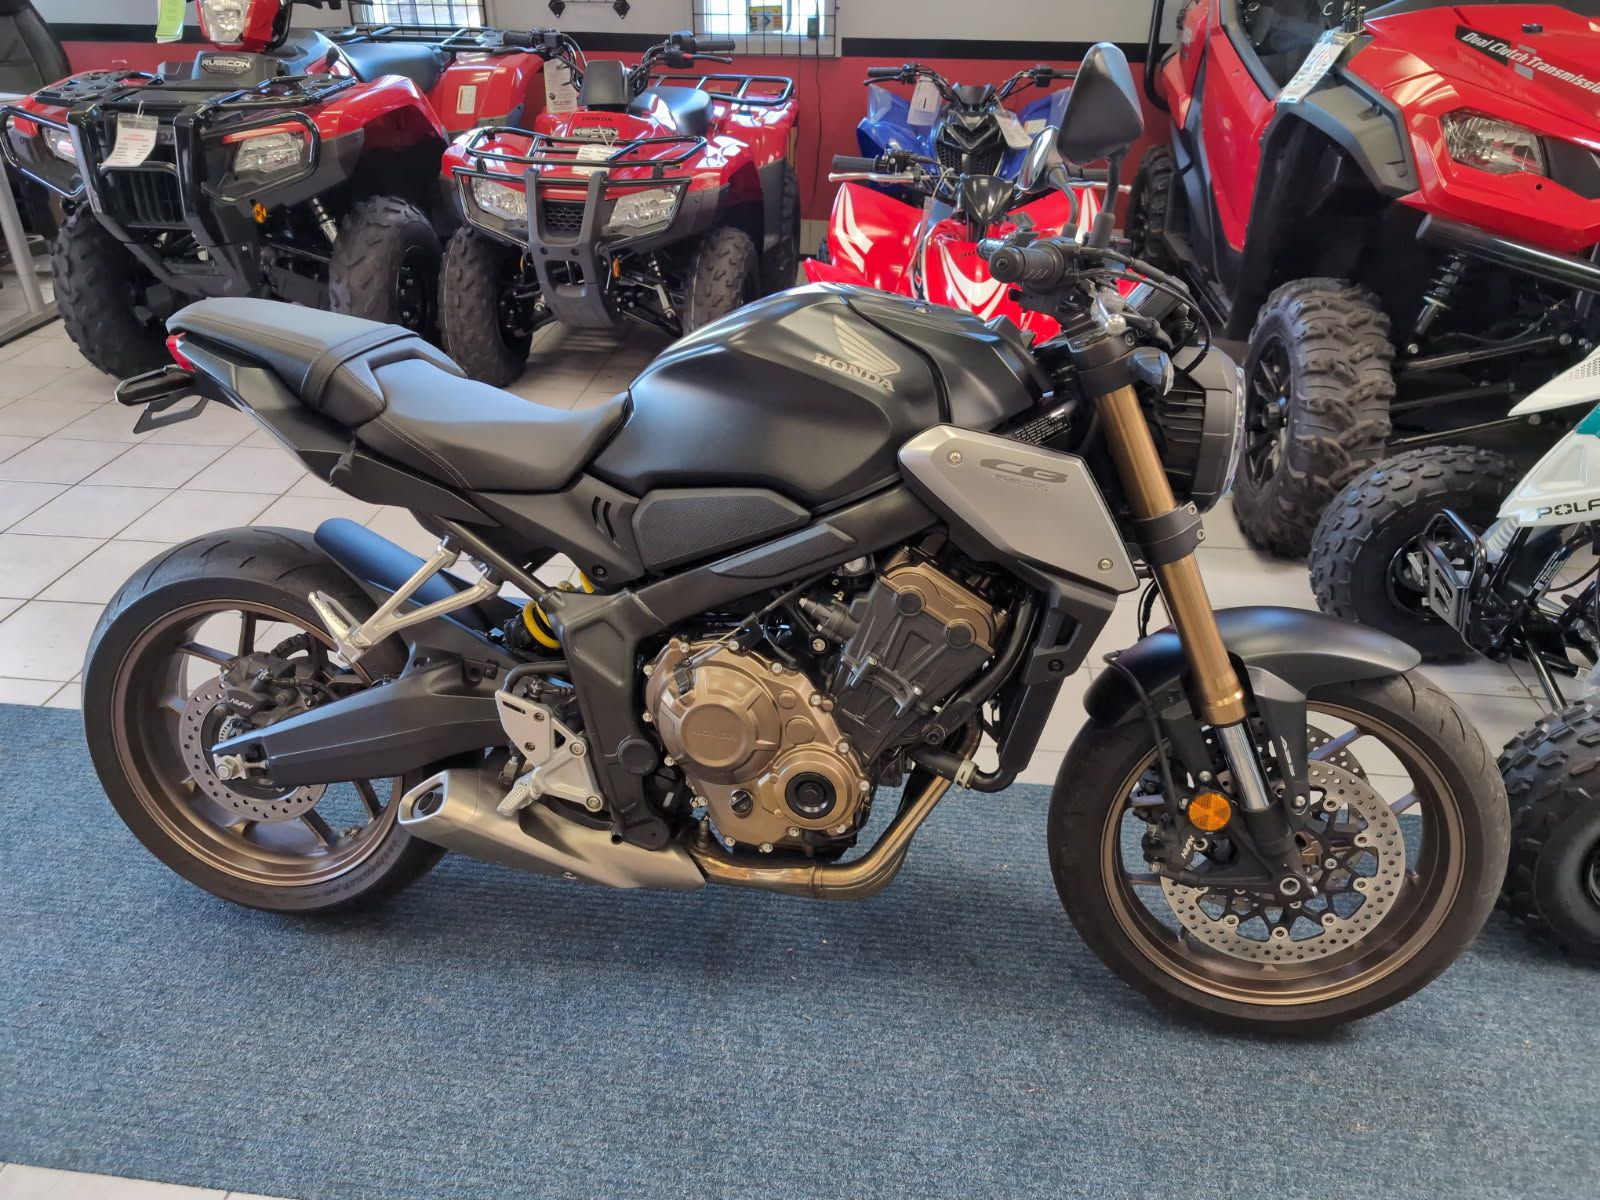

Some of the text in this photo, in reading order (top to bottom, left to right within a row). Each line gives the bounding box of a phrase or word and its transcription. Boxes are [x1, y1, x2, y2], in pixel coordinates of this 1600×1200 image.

[1461, 31, 1491, 48] Dual
[1488, 42, 1529, 63] Clutch
[201, 59, 251, 69] RUBICON
[573, 128, 618, 137] RECON
[815, 352, 895, 393] HONDA
[980, 458, 1069, 483] CB
